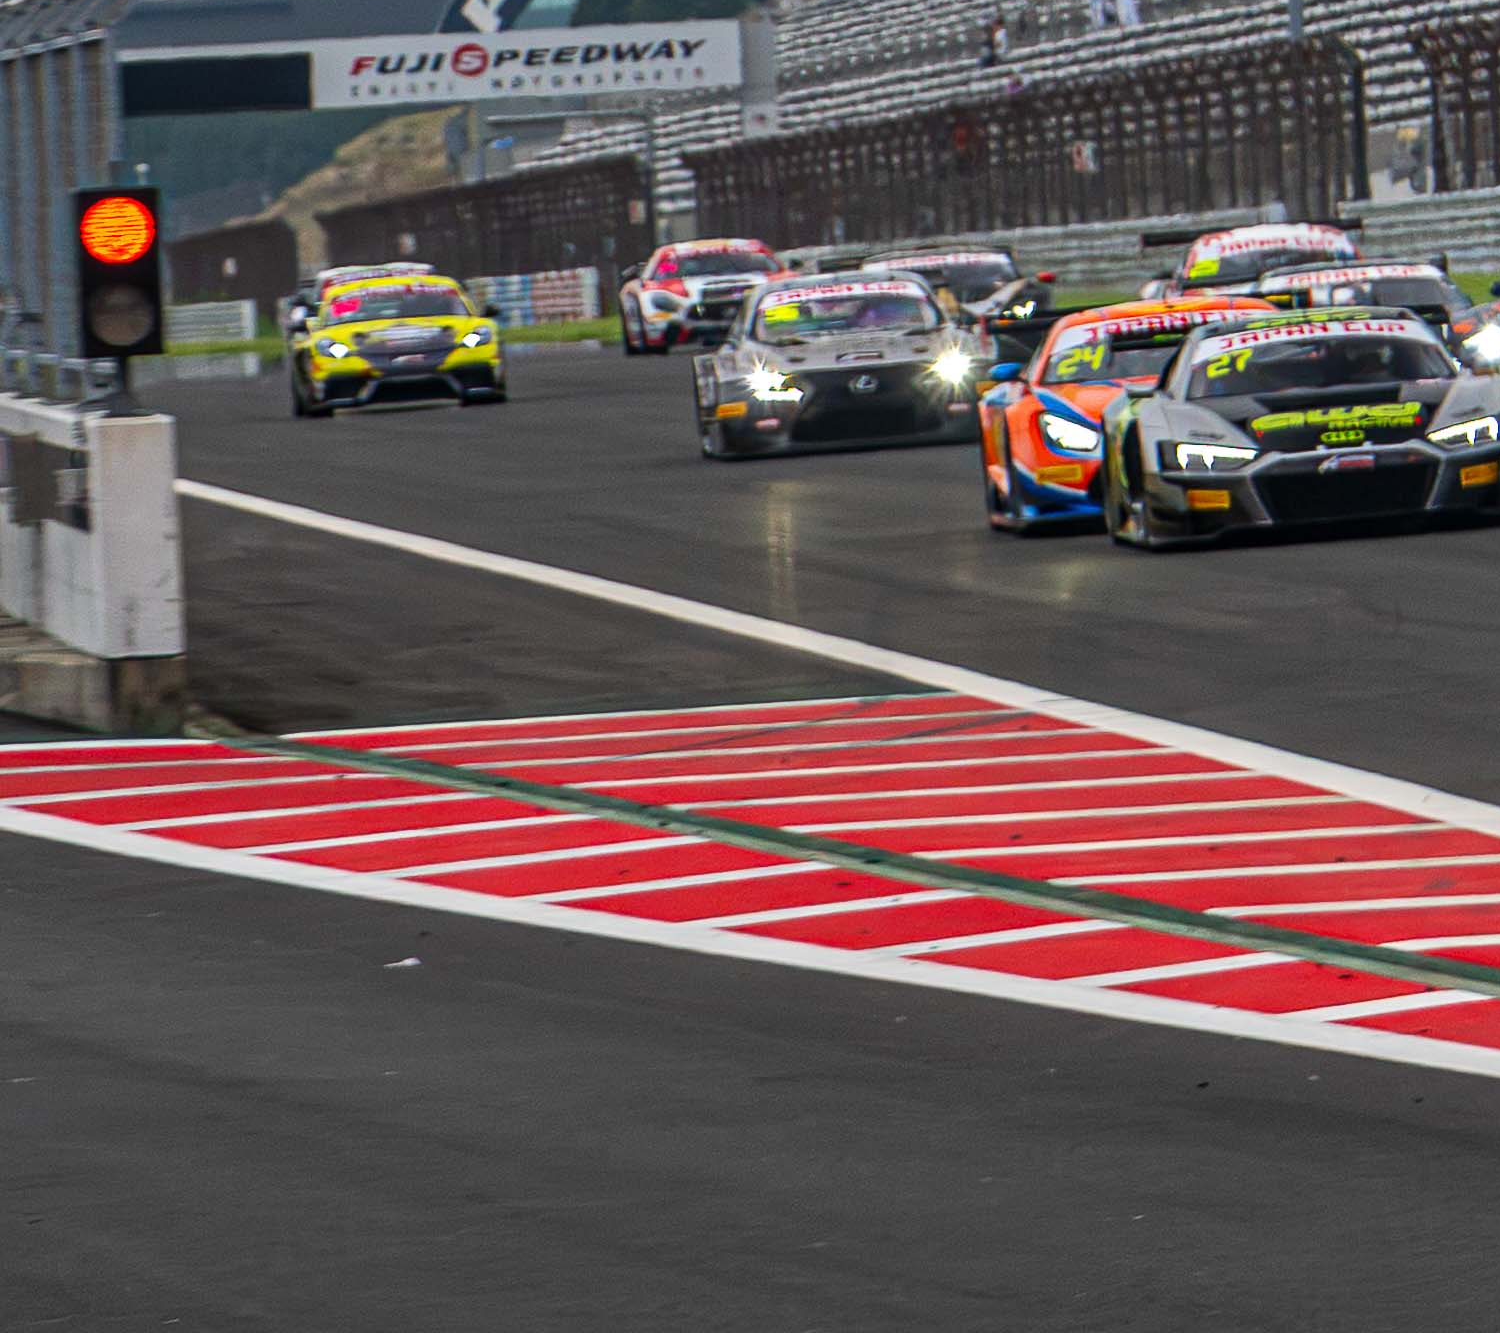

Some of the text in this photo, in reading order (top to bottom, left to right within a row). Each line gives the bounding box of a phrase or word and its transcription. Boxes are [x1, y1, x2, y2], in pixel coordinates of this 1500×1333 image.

[451, 38, 705, 78] SPEEDWAY
[1056, 344, 1105, 377] 24
[1206, 348, 1254, 380] 27
